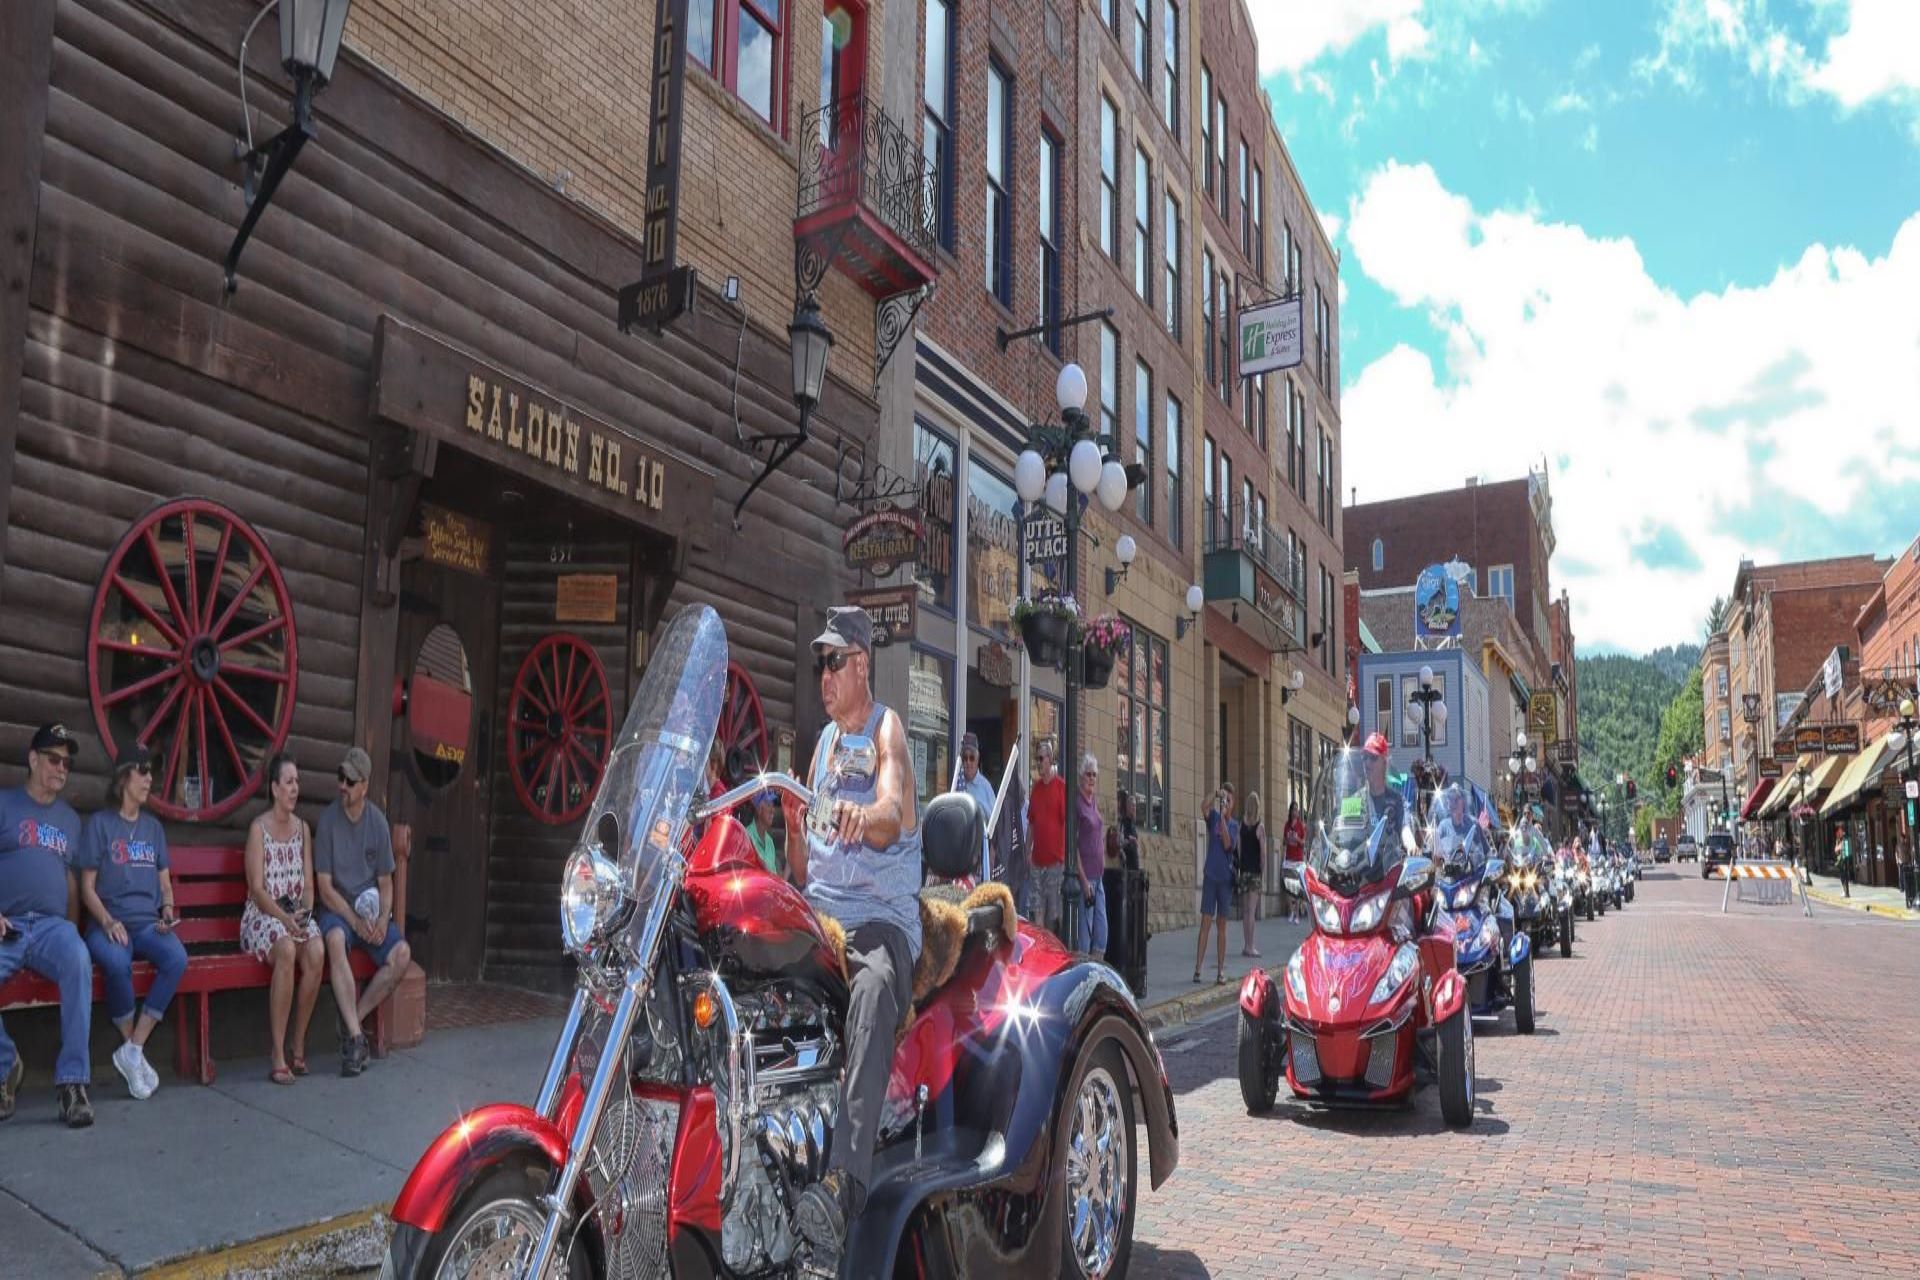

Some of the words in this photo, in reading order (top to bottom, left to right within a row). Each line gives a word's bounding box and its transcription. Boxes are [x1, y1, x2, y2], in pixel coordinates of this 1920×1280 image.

[646, 221, 666, 263] 10
[636, 282, 669, 317] 1876
[1266, 317, 1287, 329] Holiday
[1287, 316, 1297, 325] Inn
[1266, 328, 1296, 346] Express
[467, 373, 581, 475] SALOON
[588, 431, 627, 494] NO.
[635, 455, 665, 511] 10
[879, 513, 899, 522] SOCIAL
[901, 515, 916, 531] CLUB
[968, 494, 1018, 556] SALOON
[849, 537, 915, 561] RESTAURANT
[1827, 742, 1856, 751] GAMING
